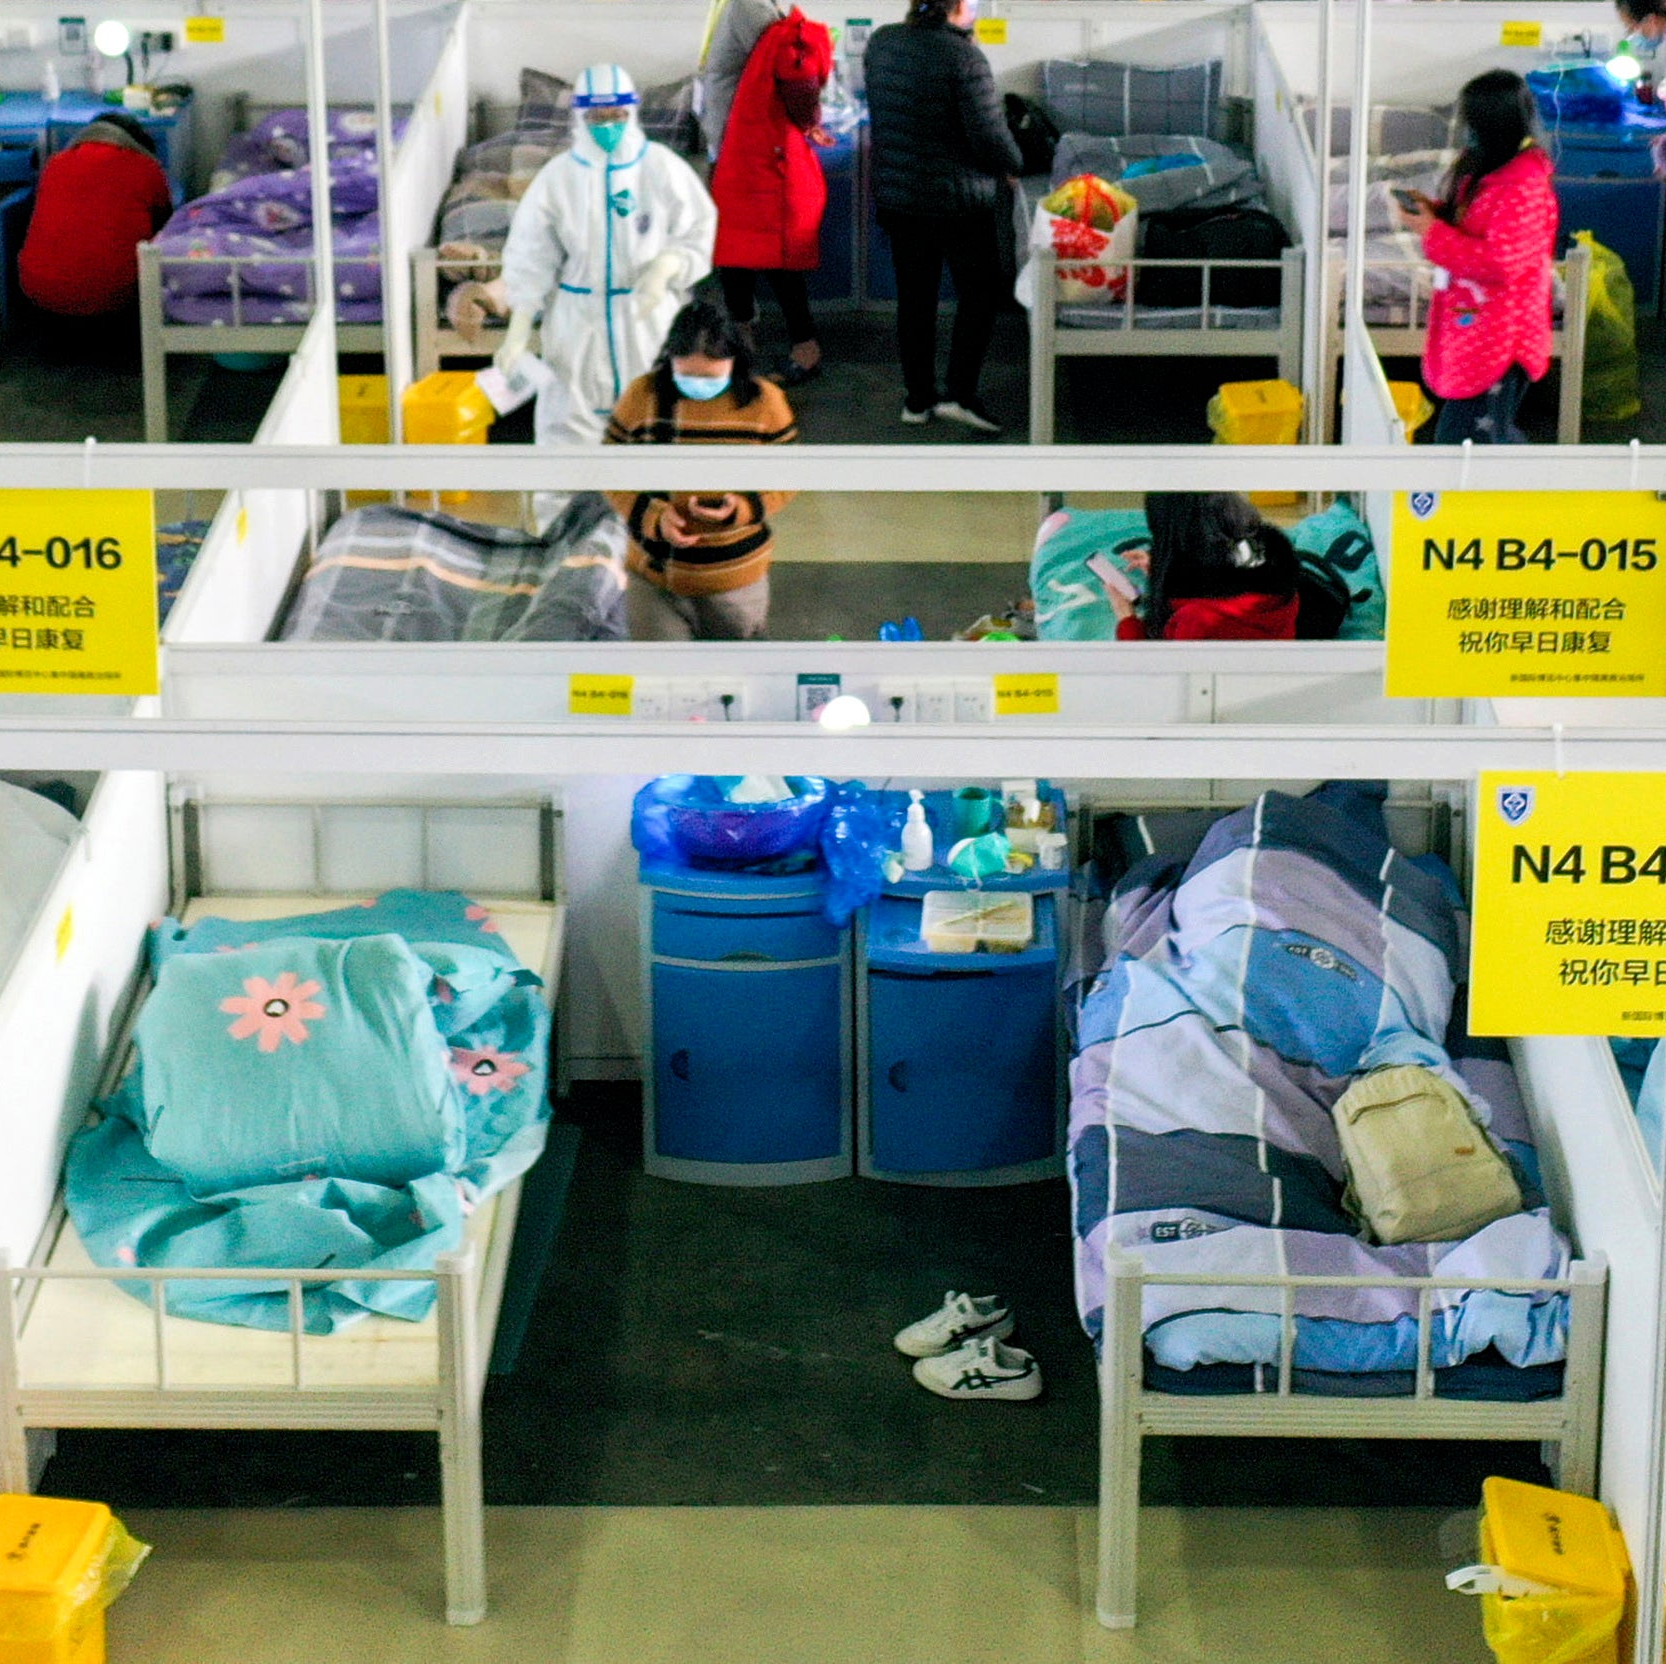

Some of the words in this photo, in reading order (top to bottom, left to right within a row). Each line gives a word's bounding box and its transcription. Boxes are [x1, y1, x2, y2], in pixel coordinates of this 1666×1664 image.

[1423, 539, 1484, 571] N4
[1497, 539, 1657, 571] B4-015
[1448, 598, 1626, 620] 感谢理解和配合
[1459, 631, 1610, 653] 祝你早日康复
[1512, 845, 1585, 886] N4
